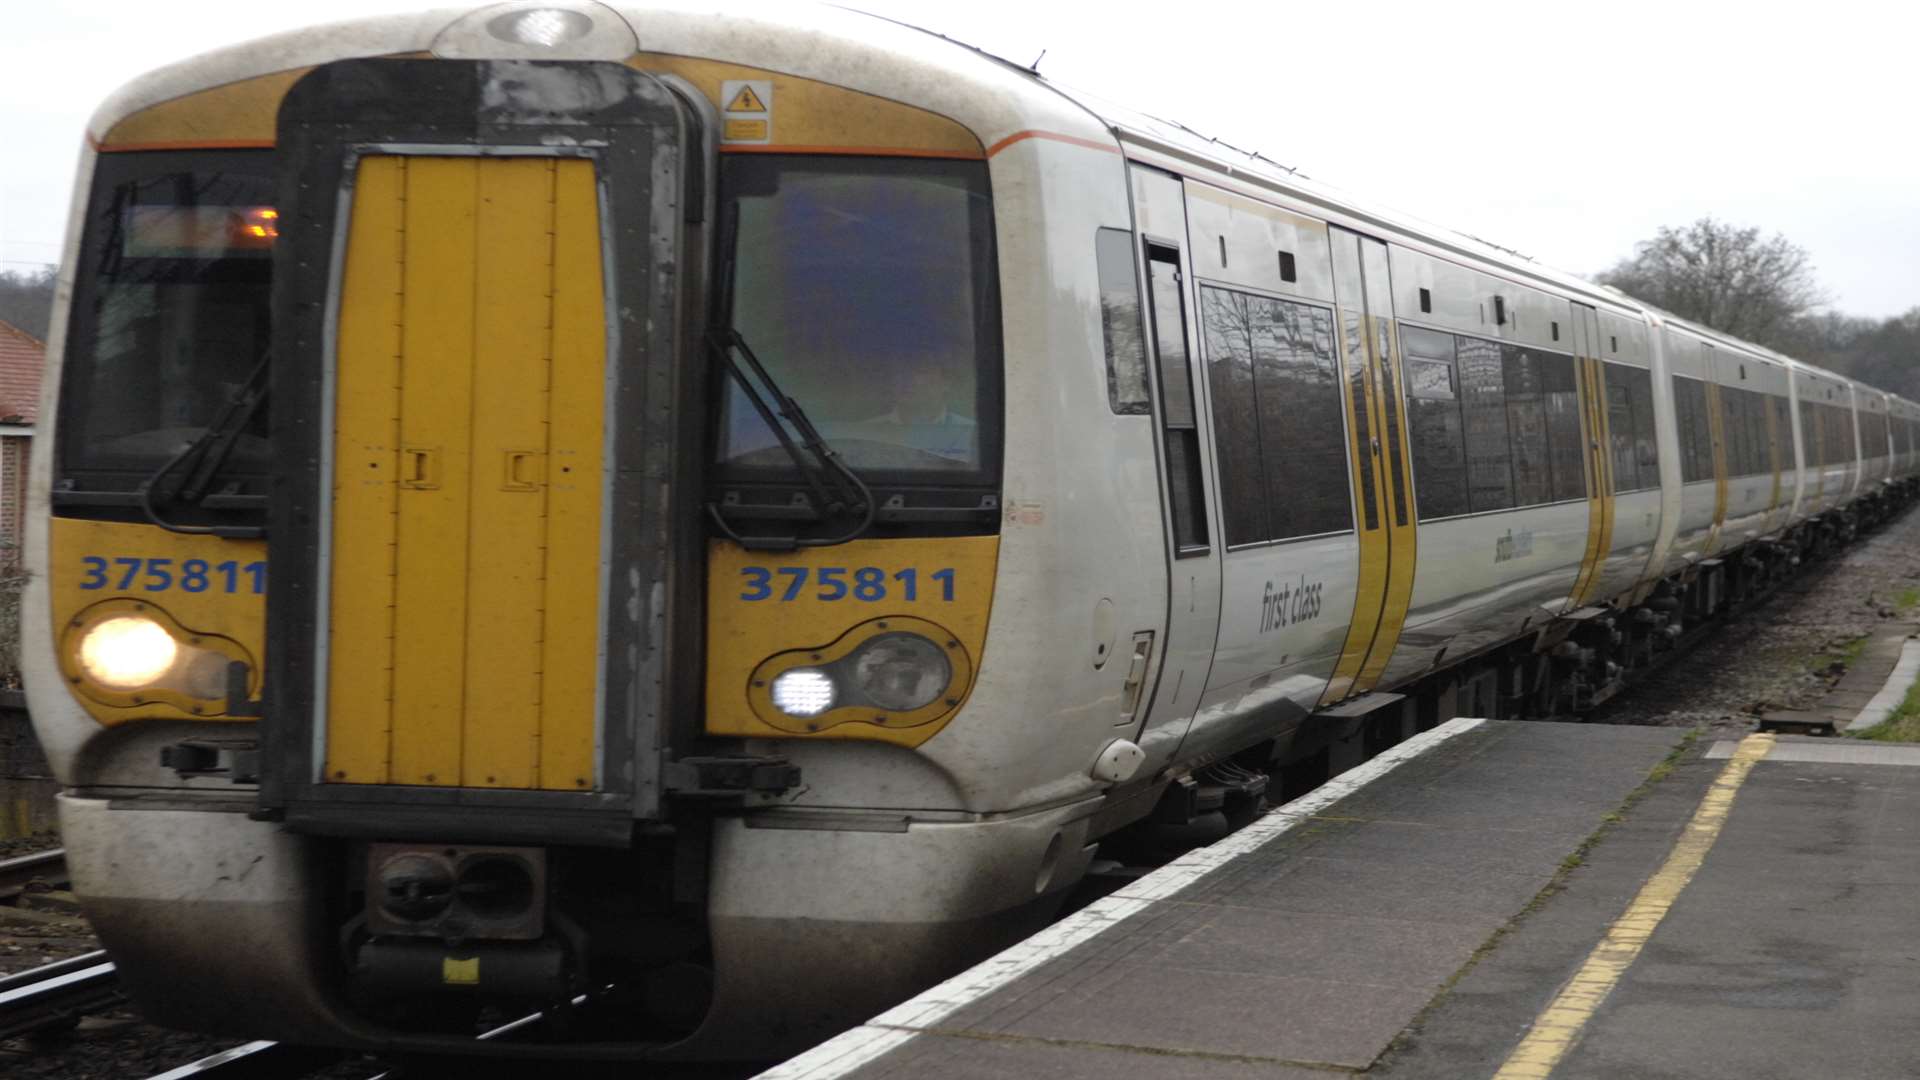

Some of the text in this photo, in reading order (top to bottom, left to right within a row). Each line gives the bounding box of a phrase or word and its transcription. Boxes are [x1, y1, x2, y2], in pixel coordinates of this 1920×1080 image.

[80, 556, 267, 593] 375811
[740, 566, 955, 602] 375811
[1260, 573, 1322, 633] first class
